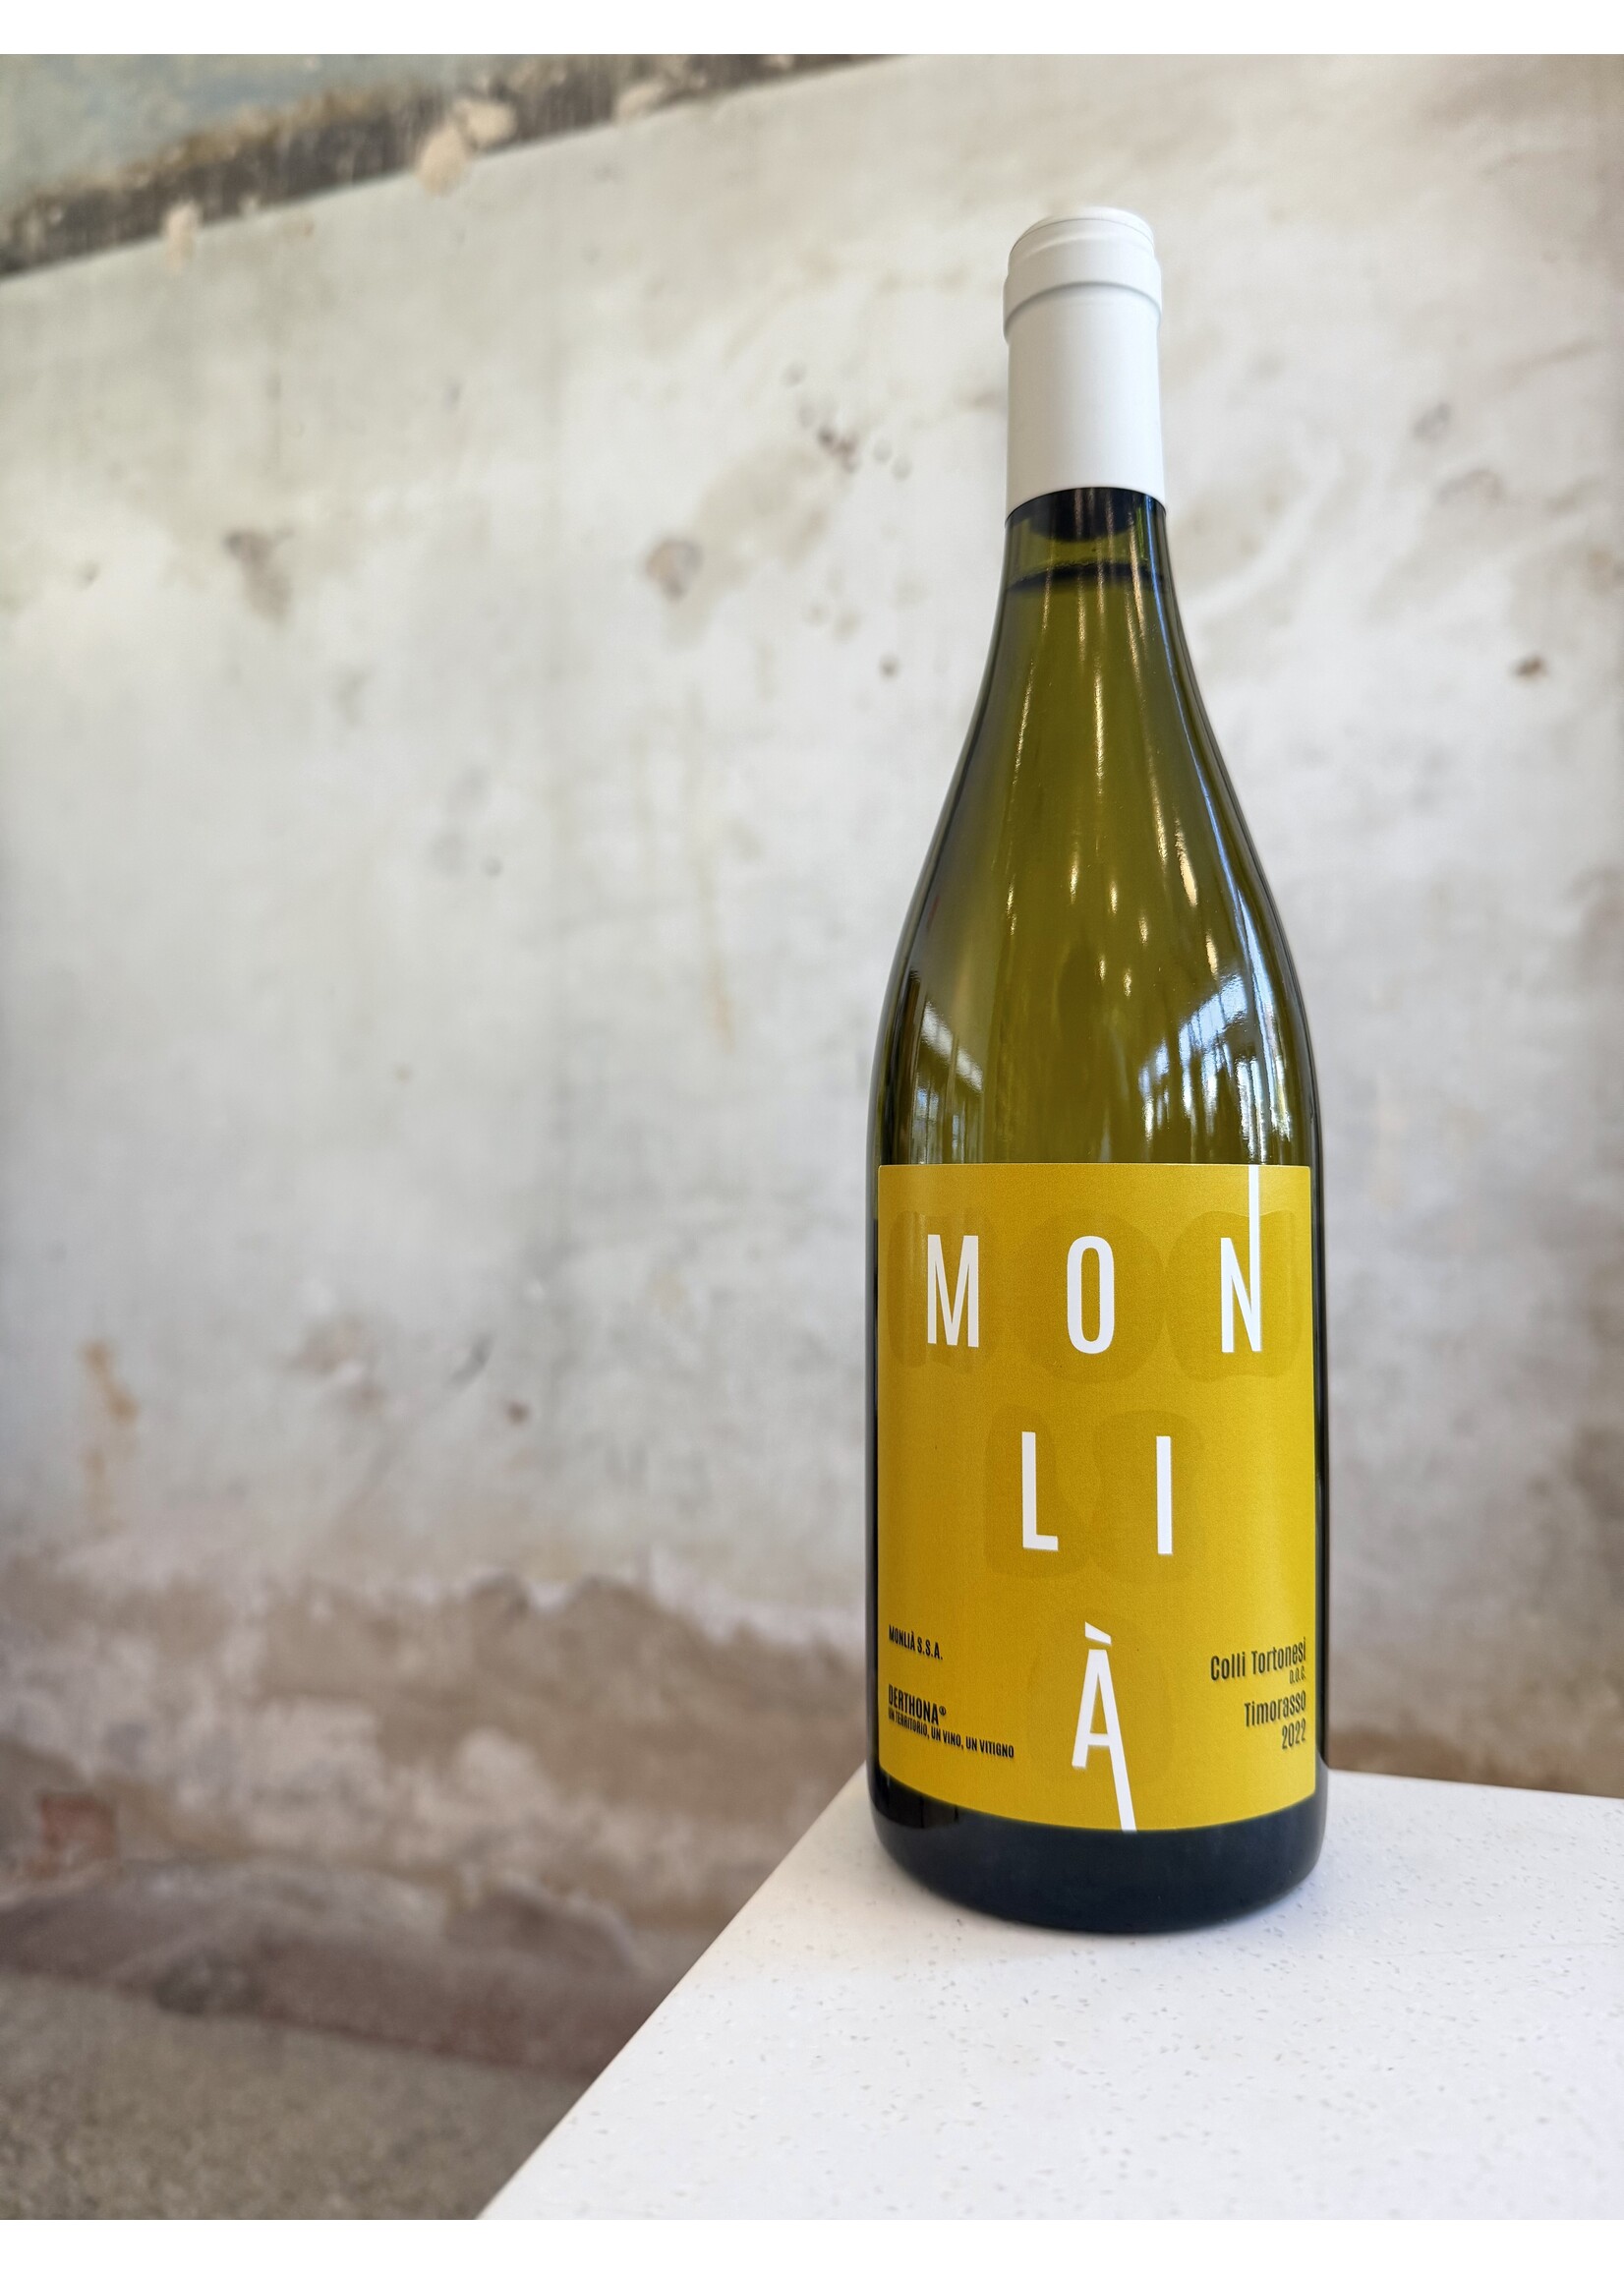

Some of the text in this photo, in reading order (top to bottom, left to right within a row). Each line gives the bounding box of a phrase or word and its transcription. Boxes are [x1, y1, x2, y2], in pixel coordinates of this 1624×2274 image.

[889, 1624, 944, 1661] MONLIÀ S.S.A.
[1210, 1636, 1306, 1681] Colli Tortonesi
[1244, 1689, 1306, 1727] Timorasso
[888, 1706, 1015, 1759] UN TERRITORIO, UN VINO, UN VITIGNO
[1282, 1718, 1306, 1749] 2022
